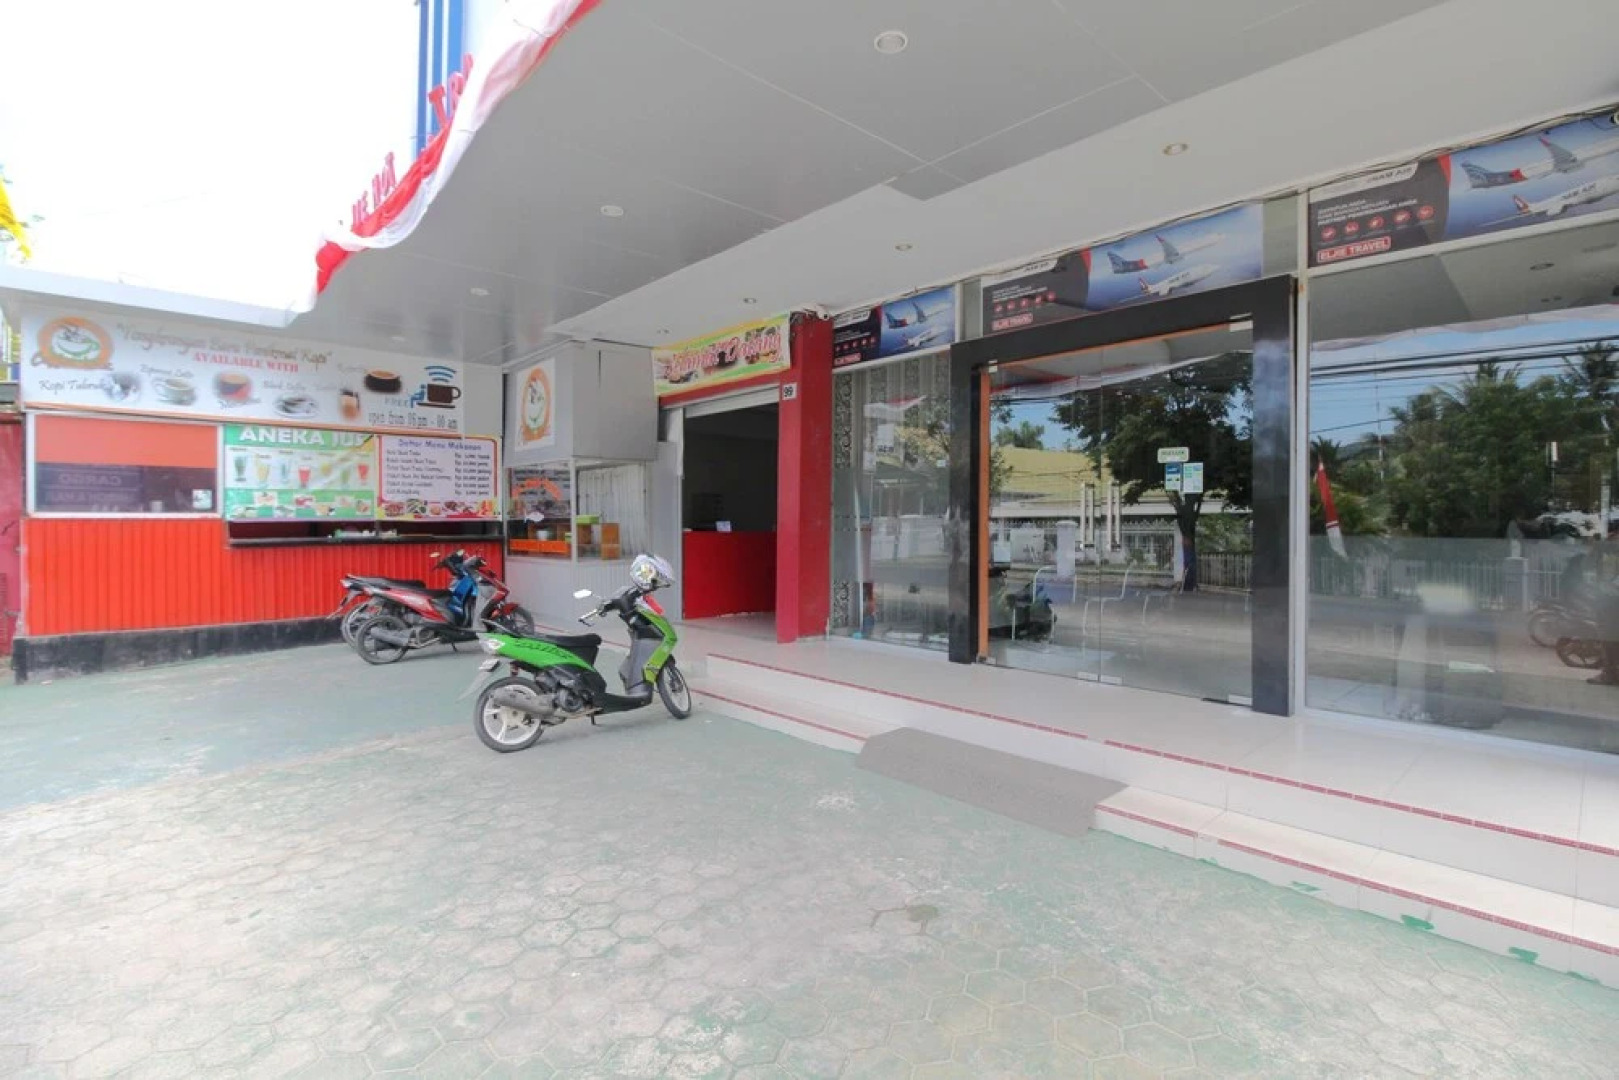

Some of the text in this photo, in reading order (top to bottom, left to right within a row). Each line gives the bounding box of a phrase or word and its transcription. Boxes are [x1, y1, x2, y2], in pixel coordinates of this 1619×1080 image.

[1350, 238, 1390, 256] TRAVEL
[192, 352, 300, 374] AVAILABLE WITH
[239, 424, 325, 446] ANEKA
